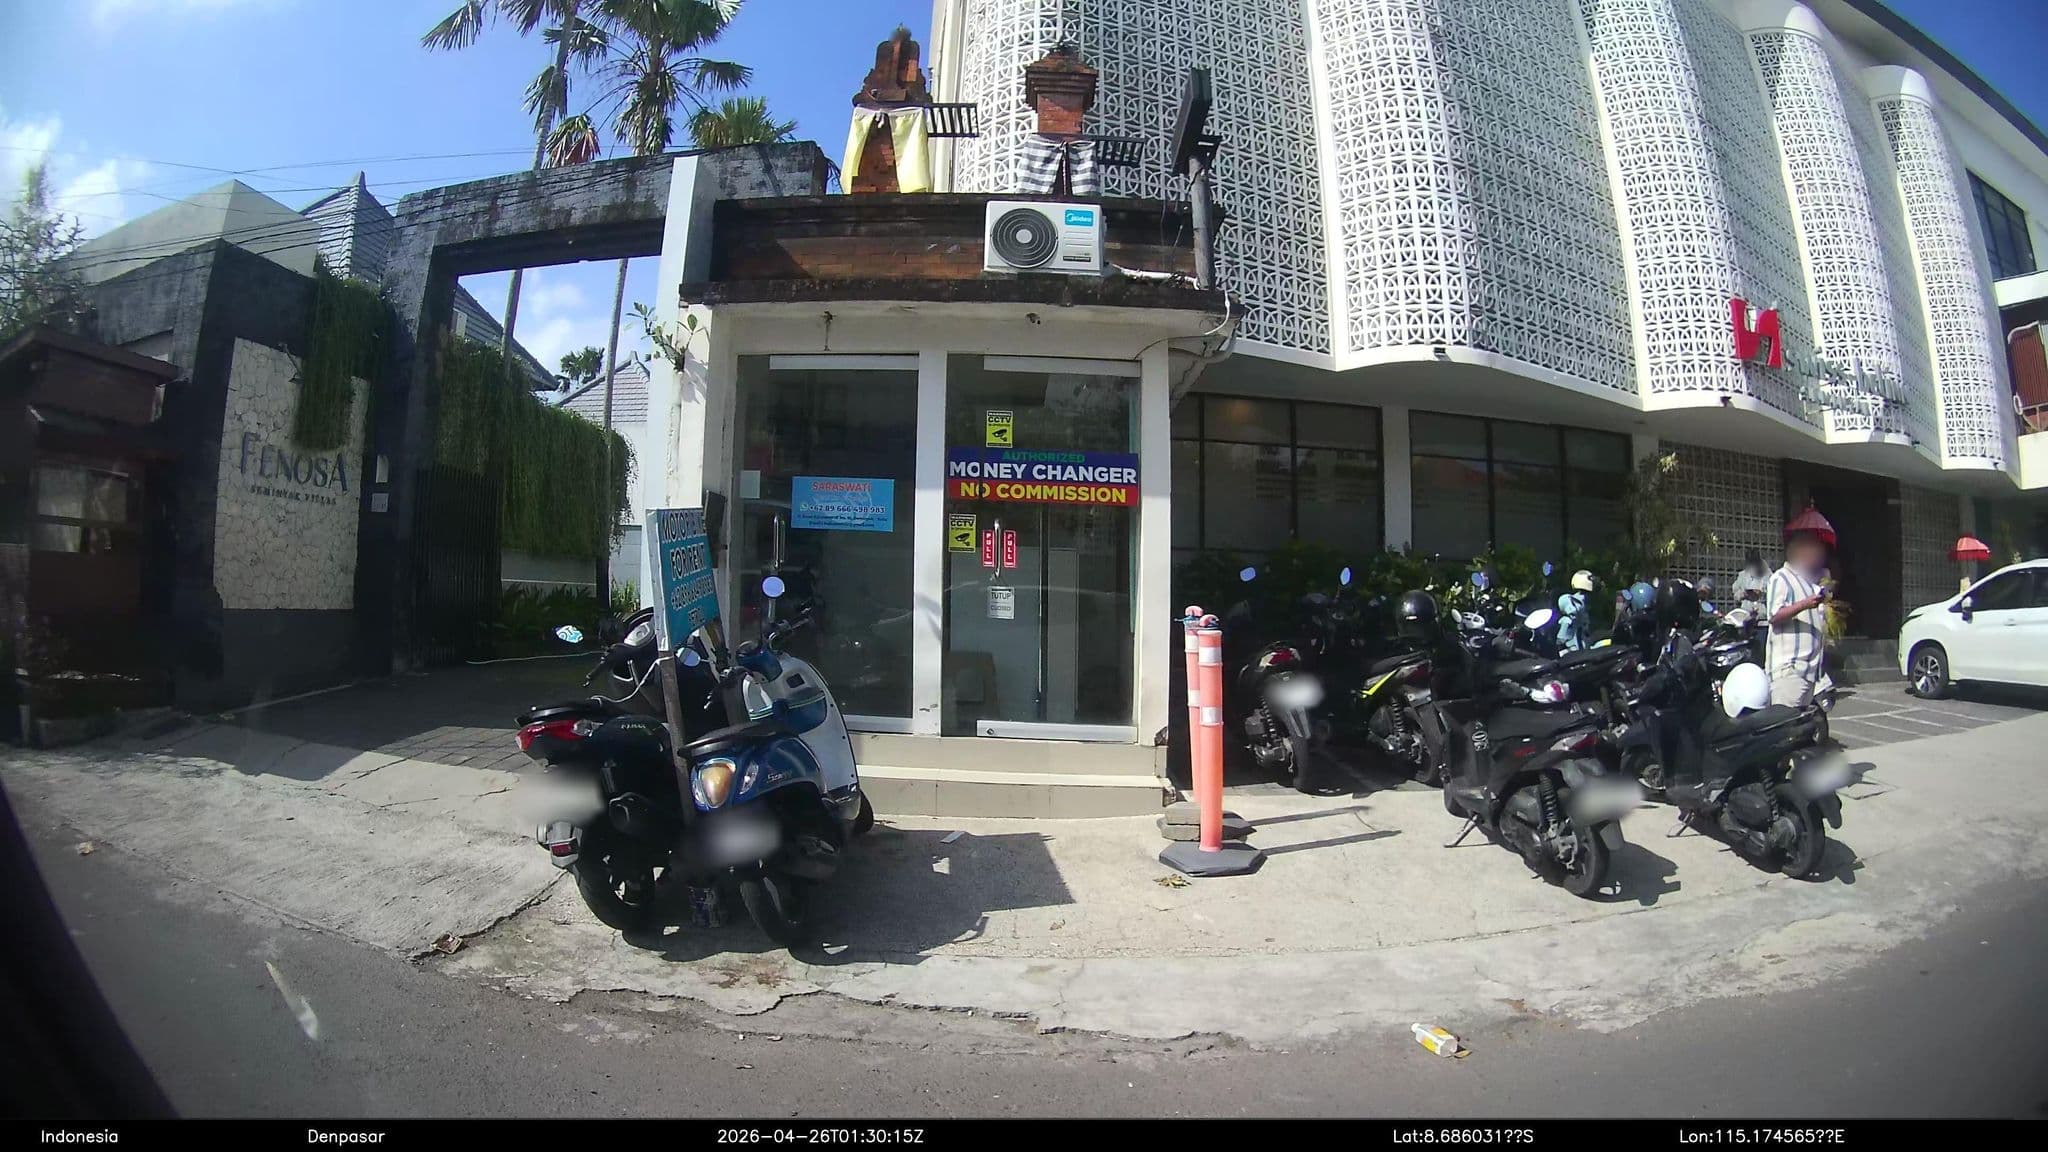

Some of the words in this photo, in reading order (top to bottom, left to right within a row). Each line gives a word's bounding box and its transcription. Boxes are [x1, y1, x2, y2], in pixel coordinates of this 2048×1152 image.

[987, 416, 1011, 424] CCTV
[240, 432, 349, 493] FENOSA
[1002, 452, 1086, 463] AUTHORIZED
[949, 461, 1028, 480] MONEY
[1032, 464, 1137, 484] CHANGER
[960, 482, 991, 498] NO
[995, 483, 1126, 503] COMMISSION
[669, 547, 689, 581] FOR
[686, 542, 707, 577] RENT
[991, 592, 1011, 600] TUTUP
